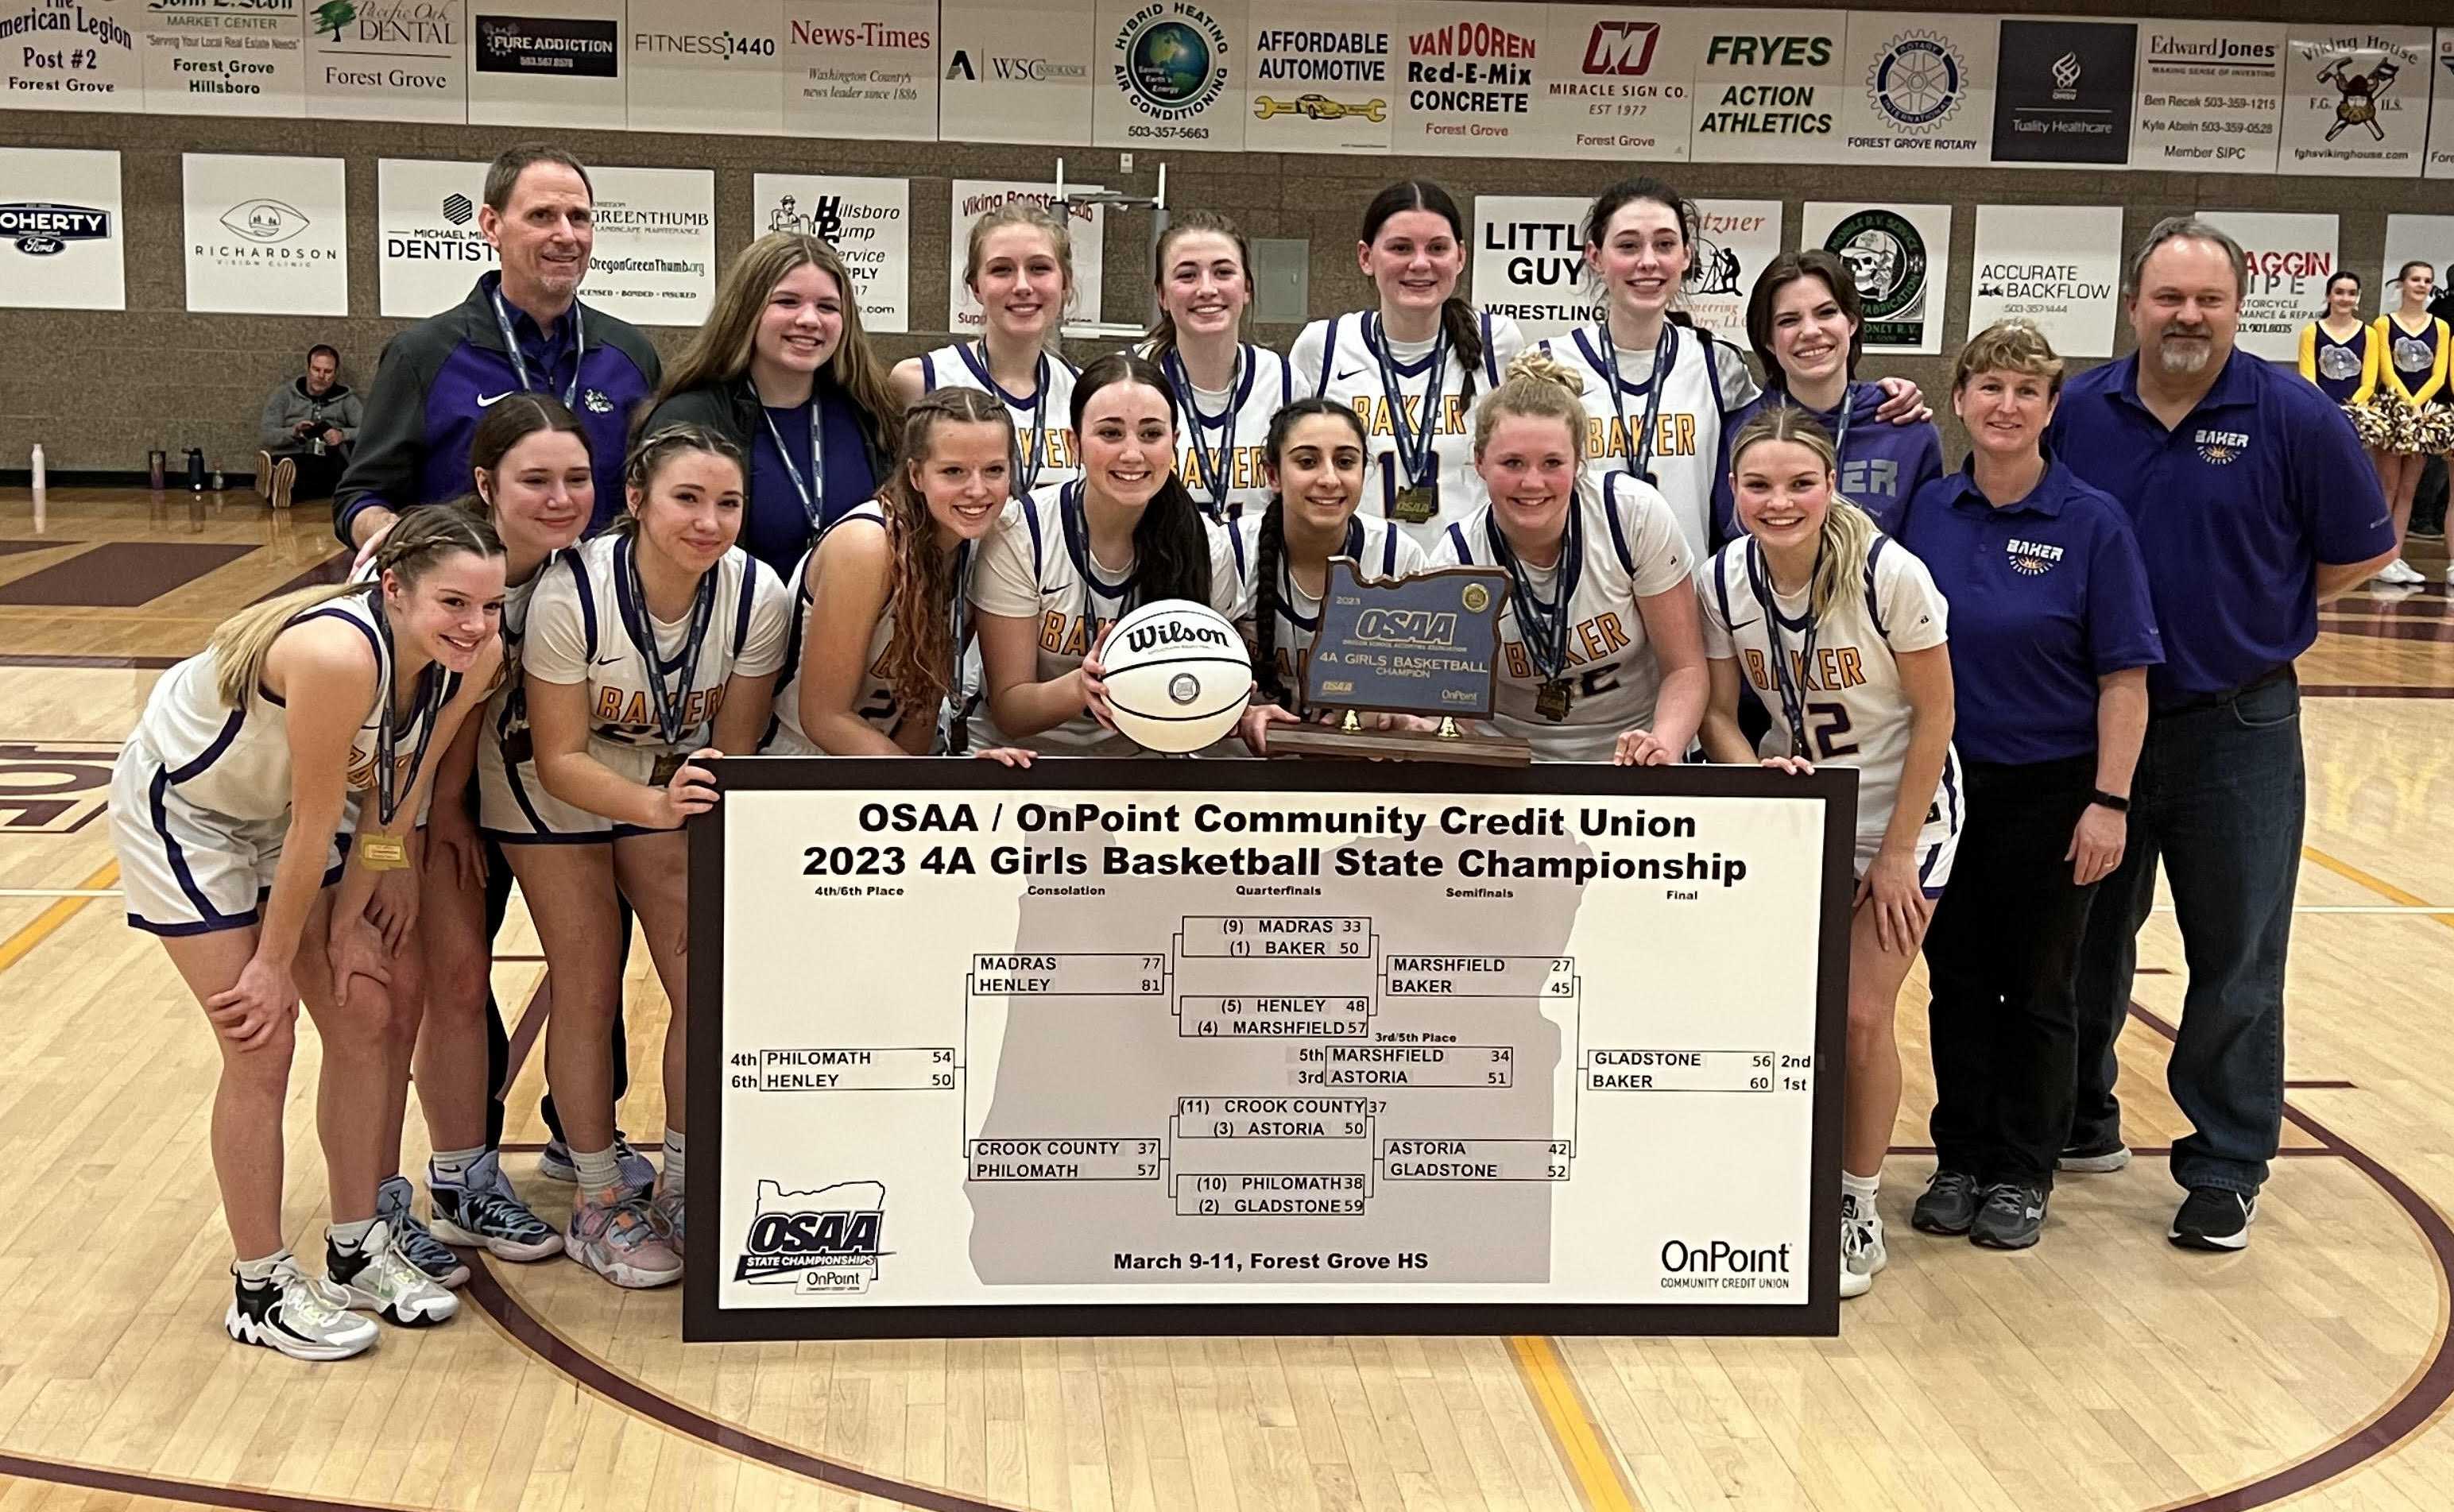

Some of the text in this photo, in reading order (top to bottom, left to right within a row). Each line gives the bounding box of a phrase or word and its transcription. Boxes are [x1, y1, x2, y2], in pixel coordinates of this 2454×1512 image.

[77, 6, 132, 50] Legion
[167, 16, 277, 29] MARKET CENTER
[1115, 3, 1163, 50] HYBRID
[1174, 2, 1229, 54] HEATING
[360, 20, 459, 44] DENTAL
[790, 20, 931, 48] News-Times
[494, 37, 614, 53] PURE ADDICTION
[1257, 30, 1388, 54] AFFORDABLE
[1408, 22, 1536, 59] VAN DOREN
[2151, 35, 2276, 59] Edward Jones
[1706, 36, 1833, 67] FRYES
[2302, 35, 2419, 65] Viking House
[23, 47, 97, 69] Post #2
[173, 59, 274, 73] Forest Grove
[1258, 58, 1385, 81] AUTOMOTIVE
[1408, 61, 1532, 86] Red-E-Mix
[326, 67, 447, 88] Forest Grove
[808, 68, 867, 83] Washington
[10, 77, 115, 93] Forest Grove
[189, 79, 261, 95] Hillsboro
[1115, 65, 1228, 120] AIR CONDITIONING
[1549, 83, 1658, 98] MIRACLE SIGN
[803, 87, 890, 99] news leader since
[1721, 86, 1815, 106] ACTION
[2144, 95, 2166, 106] Ben
[1410, 90, 1529, 113] CONCRETE
[1589, 104, 1647, 116] EST 1977
[1426, 123, 1509, 137] Forest Grove
[1699, 112, 1833, 133] ATHLETICS
[2013, 119, 2113, 134] Tuality Healthcare
[1128, 126, 1210, 139] 503-357-5663
[1577, 134, 1655, 147] Forest Grove
[1848, 137, 1978, 150] FOREST GROVE ROTARY
[2164, 145, 2246, 159] Member SIPC
[814, 196, 900, 222] Hillsboro
[414, 230, 466, 239] MICHAEL
[818, 217, 875, 242] Pump
[24, 238, 56, 253] Ford
[195, 246, 336, 260] RICHARDSON
[1508, 257, 1587, 285] GUY
[1980, 265, 2079, 280] ACCURATE
[2007, 283, 2111, 300] BACKFLOW
[1485, 304, 1607, 324] WRESTLING
[1586, 413, 1695, 458] BAKER
[2195, 430, 2249, 447] BAKER
[2006, 539, 2064, 562] BAKER
[1336, 596, 1361, 605] 2023
[1356, 609, 1457, 645] OSAA
[1127, 621, 1231, 652] Wilson
[1319, 652, 1488, 674] 4A GIRLS BASKETBALL
[1375, 667, 1430, 679] CHAMPION
[1322, 680, 1355, 693] OSAA
[859, 804, 1696, 841] OSAA OnPoint Community Credit Union
[803, 847, 1748, 887] 2023 4A Girls Basketball State Championship
[867, 885, 905, 897] Place
[1028, 885, 1105, 897] Consolation
[1236, 885, 1322, 898] Quarterfinals
[1446, 887, 1514, 899] Semifinals
[1666, 890, 1698, 901] Final
[1259, 919, 1361, 934] MADRAS 33
[1265, 941, 1359, 955] BAKER 50
[981, 957, 1160, 971] MADRAS 77
[1393, 958, 1571, 973] MARSHFIELD 27
[980, 978, 1159, 992] HENLEY 81
[1392, 979, 1570, 996] BAKER 45
[1256, 999, 1365, 1013] HENLEY 48
[1233, 1020, 1367, 1035] MARSHFIELD 57
[731, 1051, 951, 1067] 4th PHILOMATH 54
[1299, 1048, 1510, 1063] 5th MARSHFIELD 34
[1594, 1052, 1811, 1069] GLADSTONE 56 2nd
[731, 1073, 951, 1089] 6th HENLEY 50
[1298, 1070, 1506, 1085] 3rd ASTORIA 51
[1593, 1074, 1769, 1090] BAKER 60
[1225, 1099, 1387, 1114] CROOK COUNTY 37
[1248, 1121, 1364, 1136] ASTORIA 50
[977, 1141, 1156, 1156] CROOK COUNTY 37
[1389, 1142, 1466, 1156] ASTORIA
[977, 1163, 1156, 1178] PHILOMATH 57
[1390, 1163, 1566, 1179] GLADSTONE 52
[1242, 1176, 1363, 1190] PHILOMATH 38
[1234, 1198, 1363, 1213] GLADSTONE 59
[746, 1211, 884, 1255] OSAA
[1113, 1253, 1428, 1274] March 9-11, Forest Grove HS
[1661, 1240, 1790, 1274] OnPoint
[807, 1271, 860, 1286] OnPoint
[1661, 1277, 1719, 1289] COMMUNITY
